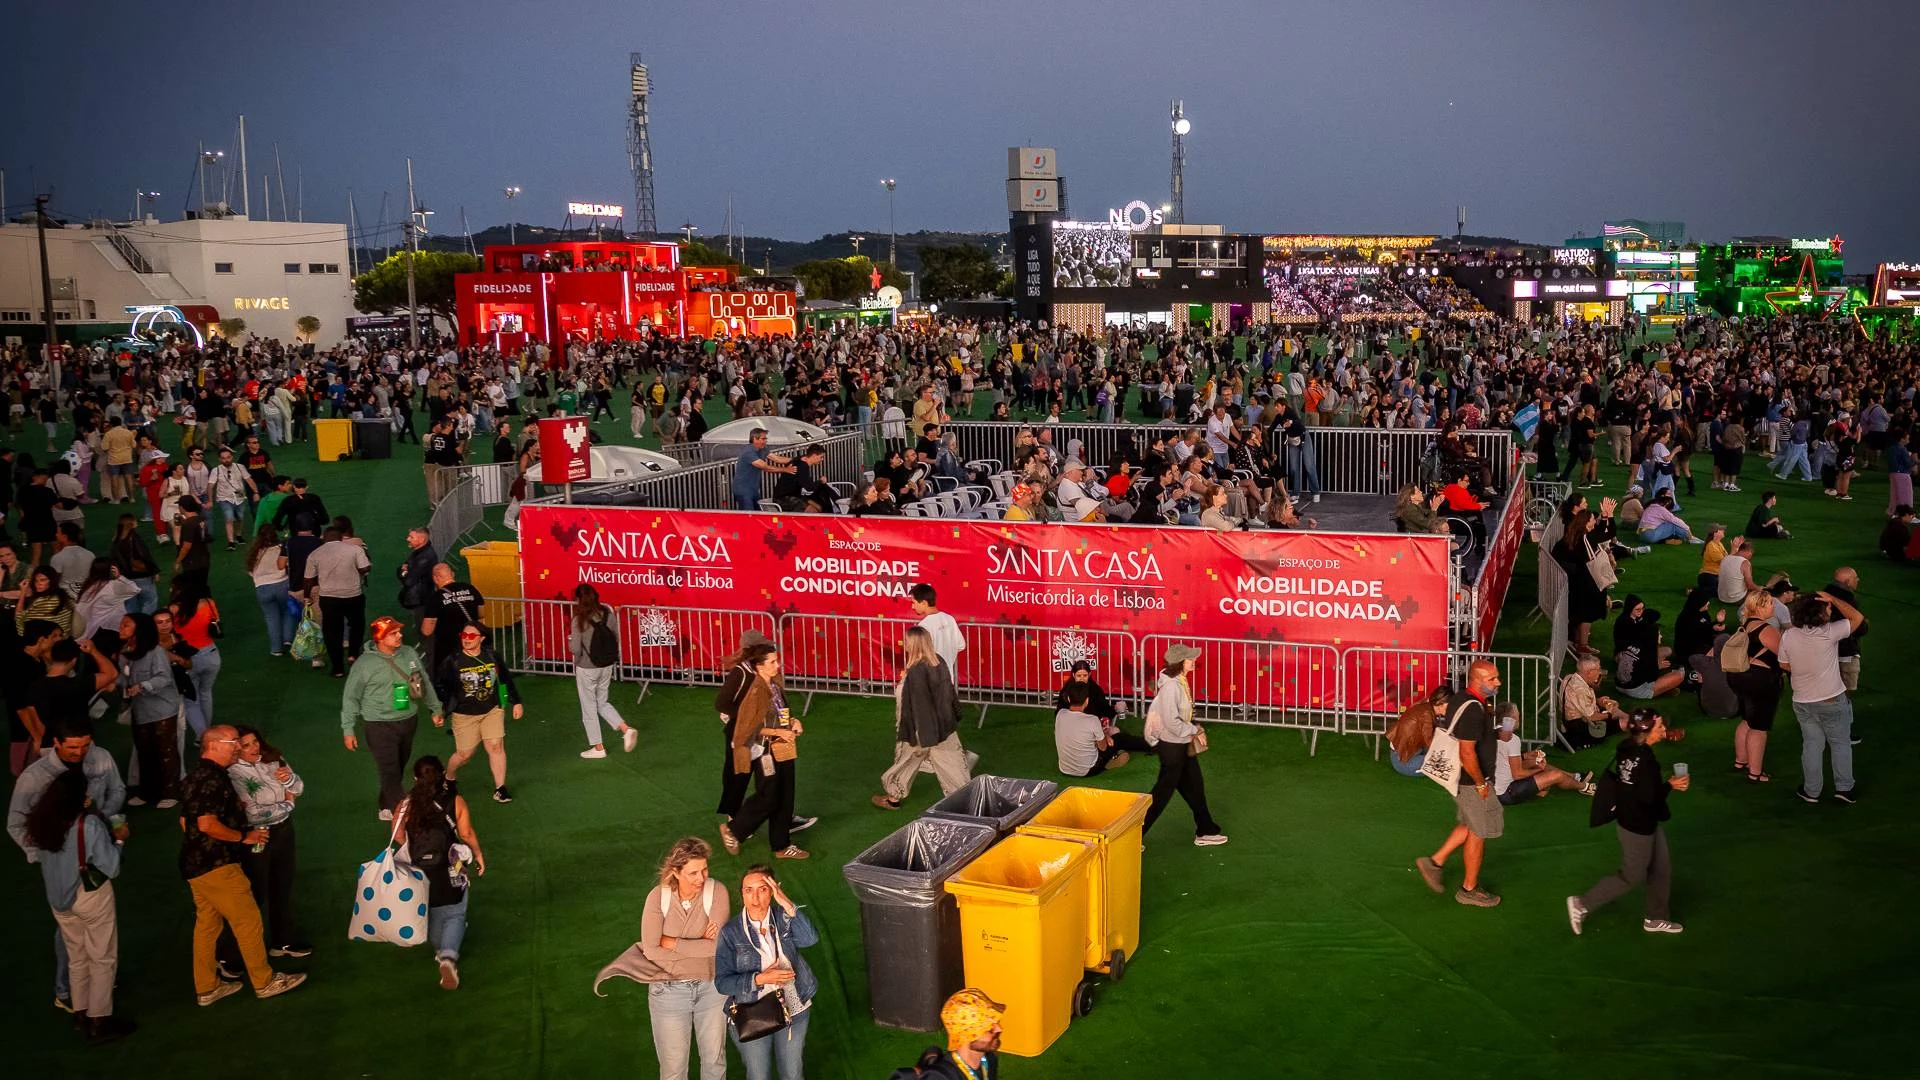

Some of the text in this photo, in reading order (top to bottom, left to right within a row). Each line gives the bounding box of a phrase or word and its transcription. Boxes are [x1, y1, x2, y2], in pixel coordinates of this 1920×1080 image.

[1109, 200, 1163, 232] NOS
[1569, 248, 1590, 258] TUDO
[1027, 261, 1041, 272] TUDO
[1298, 267, 1315, 275] LIGA
[1344, 267, 1359, 275] QUE
[1886, 262, 1909, 272] Music
[474, 284, 532, 294] FIDELIDADE
[635, 282, 675, 292] FIDELIDADE
[234, 297, 290, 310] RIVAGE
[1353, 294, 1373, 305] NOS
[577, 529, 731, 562] SANTA CASA
[829, 540, 881, 552] ESPAÇO DE
[795, 556, 920, 577] MOBILIDADE
[987, 545, 1163, 581] SANTA CASA
[1279, 559, 1340, 570] ESPAÇO DE
[578, 566, 734, 589] Misericórdia de Lisboa
[780, 576, 931, 598] CONDICIONA
[1237, 576, 1382, 598] MOBILIDADE
[987, 584, 1165, 610] Misericórdia de Lisboa
[1219, 597, 1401, 621] CONDICIONADA
[641, 634, 666, 645] alive
[1054, 657, 1075, 671] aliv
